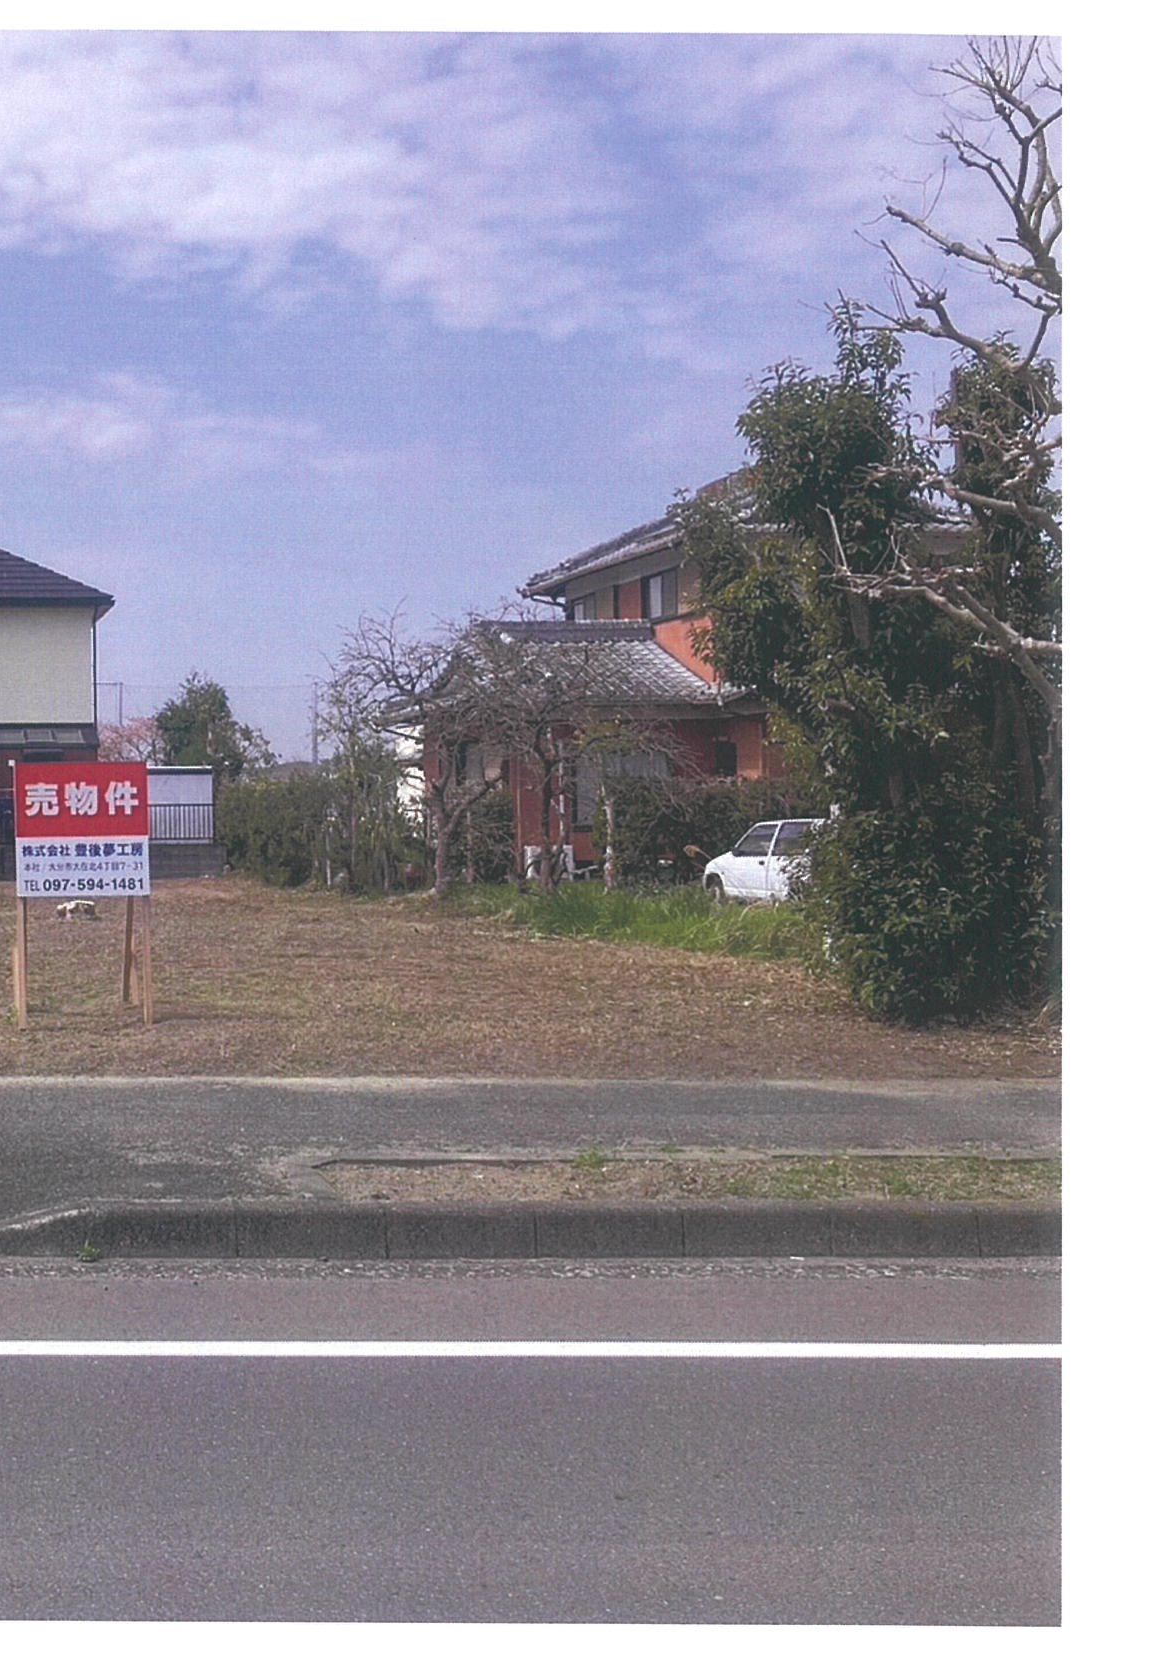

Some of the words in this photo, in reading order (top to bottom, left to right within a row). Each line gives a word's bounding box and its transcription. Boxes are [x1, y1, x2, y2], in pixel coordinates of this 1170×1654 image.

[24, 781, 139, 816] 売物件
[22, 844, 71, 857] 株式会社
[75, 843, 143, 857] 豊後夢工房
[24, 880, 40, 891] TEL
[43, 878, 144, 891] 097-594-1481
